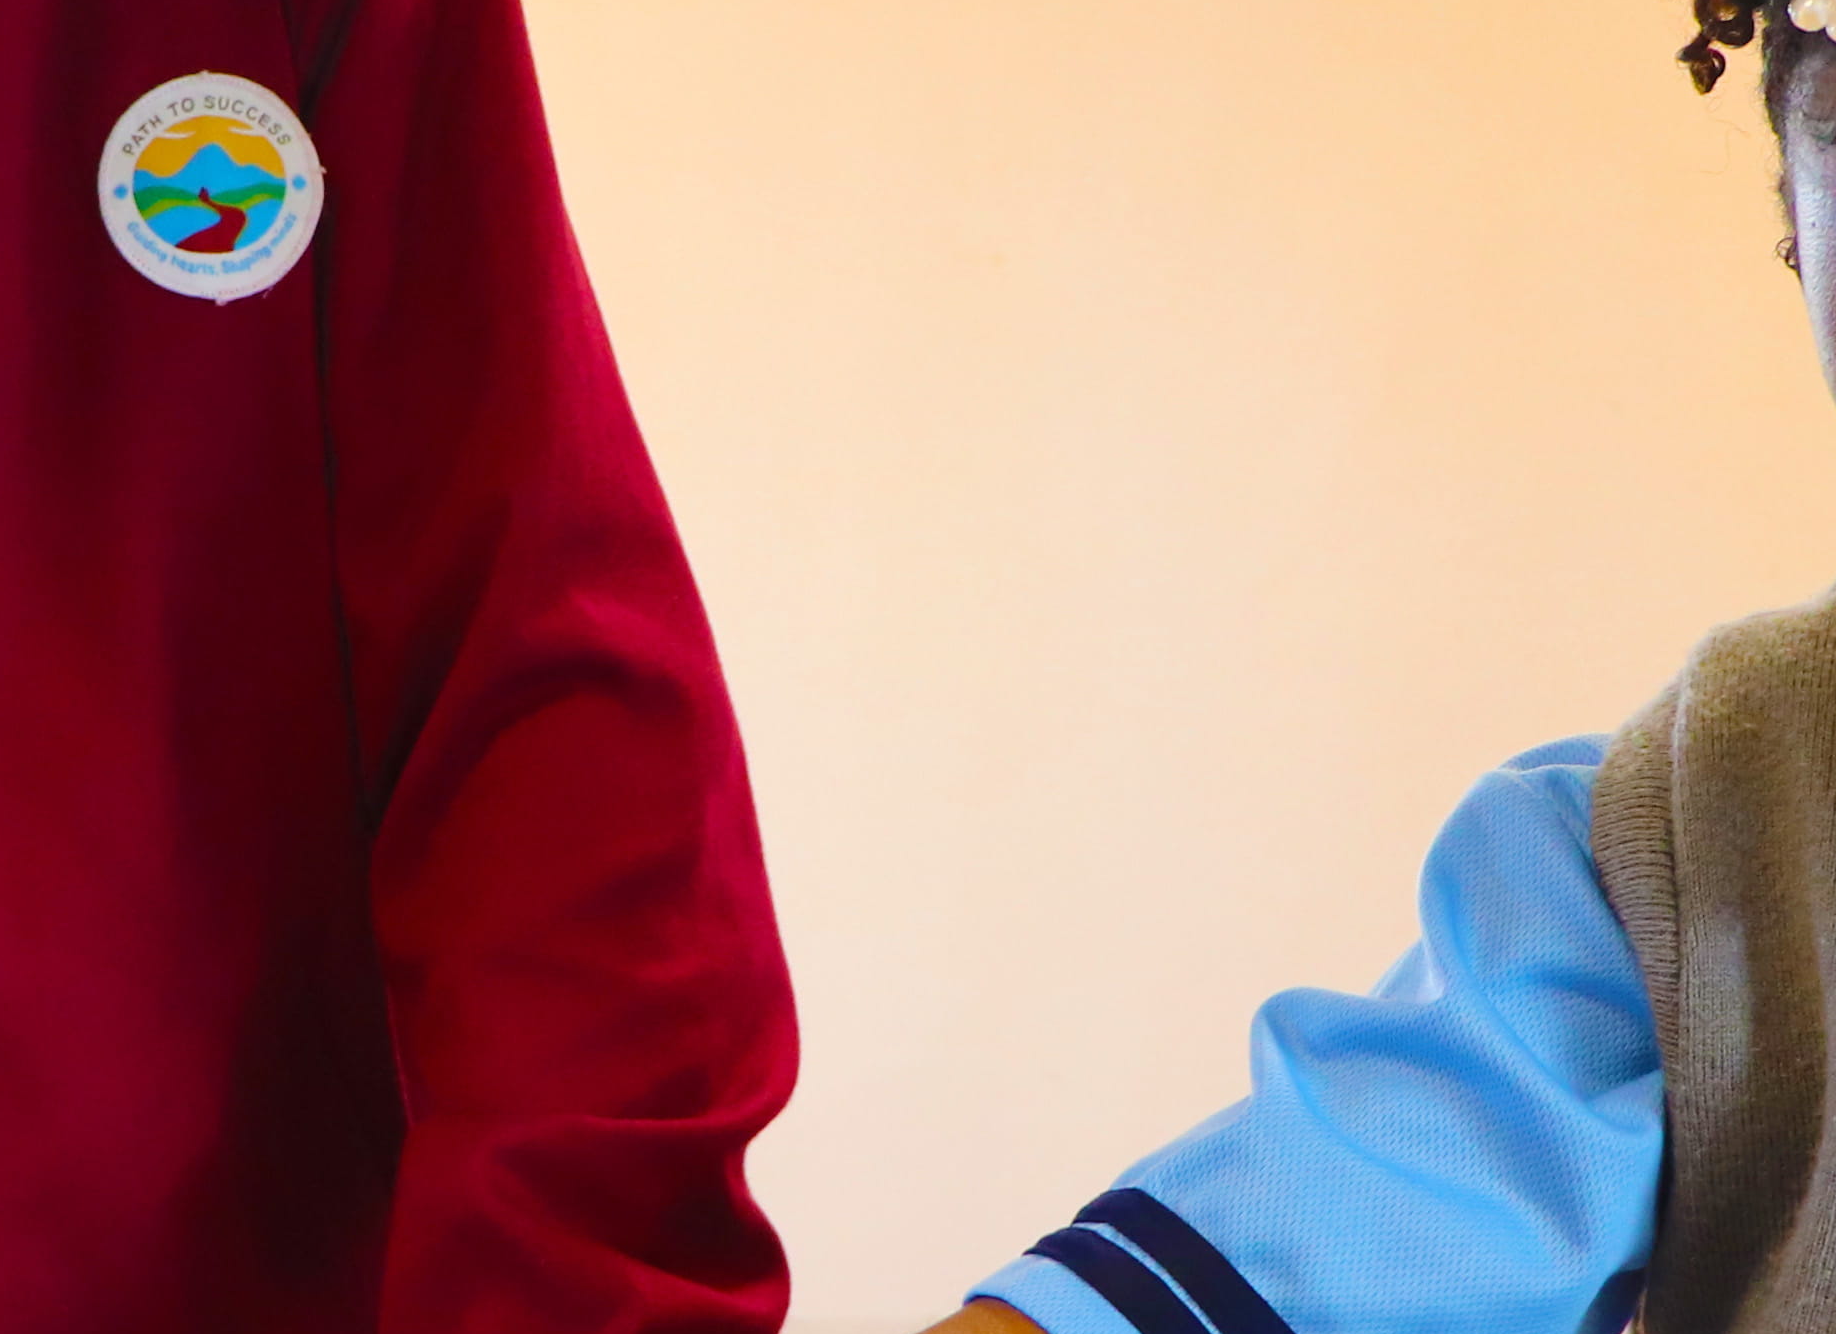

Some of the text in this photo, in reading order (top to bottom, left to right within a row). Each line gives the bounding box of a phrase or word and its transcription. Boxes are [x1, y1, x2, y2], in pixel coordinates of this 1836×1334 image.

[122, 95, 292, 155] PATH TO SUCCESS
